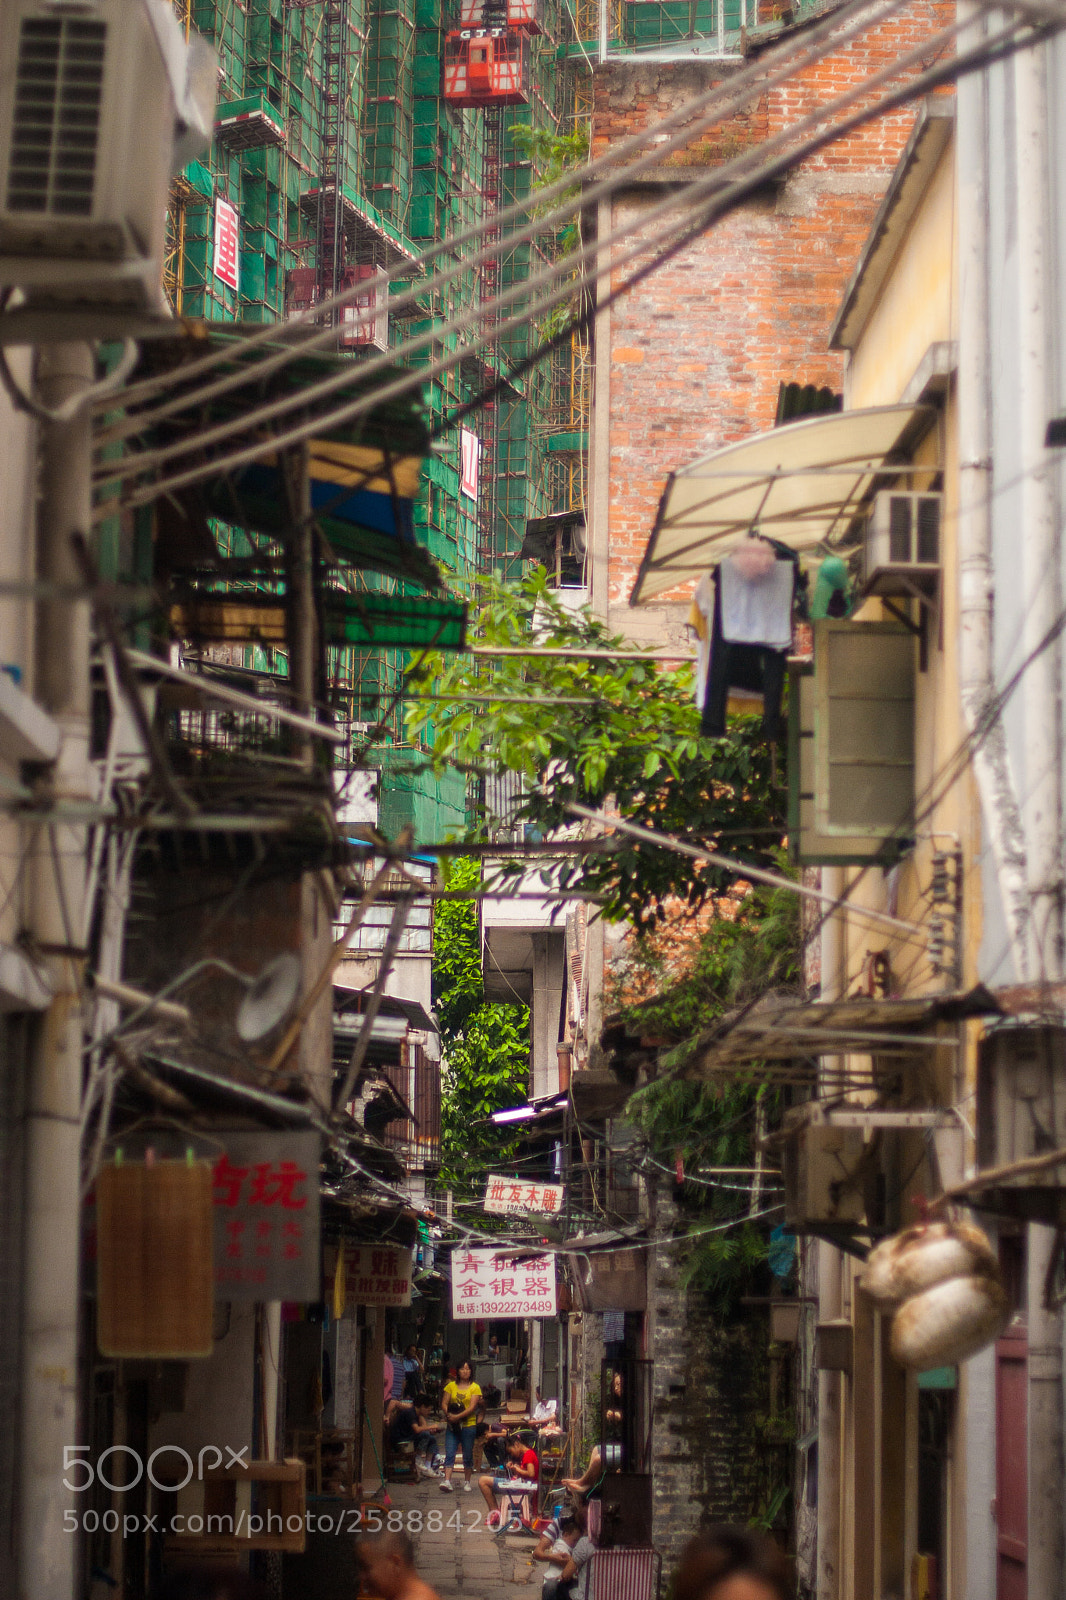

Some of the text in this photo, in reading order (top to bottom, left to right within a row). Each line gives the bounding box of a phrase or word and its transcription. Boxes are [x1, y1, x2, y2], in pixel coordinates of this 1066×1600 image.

[460, 28, 503, 40] GJJ
[490, 1180, 558, 1211] 批发木雕
[455, 1277, 552, 1299] 金银器
[456, 1300, 553, 1315] 电话:13922273489
